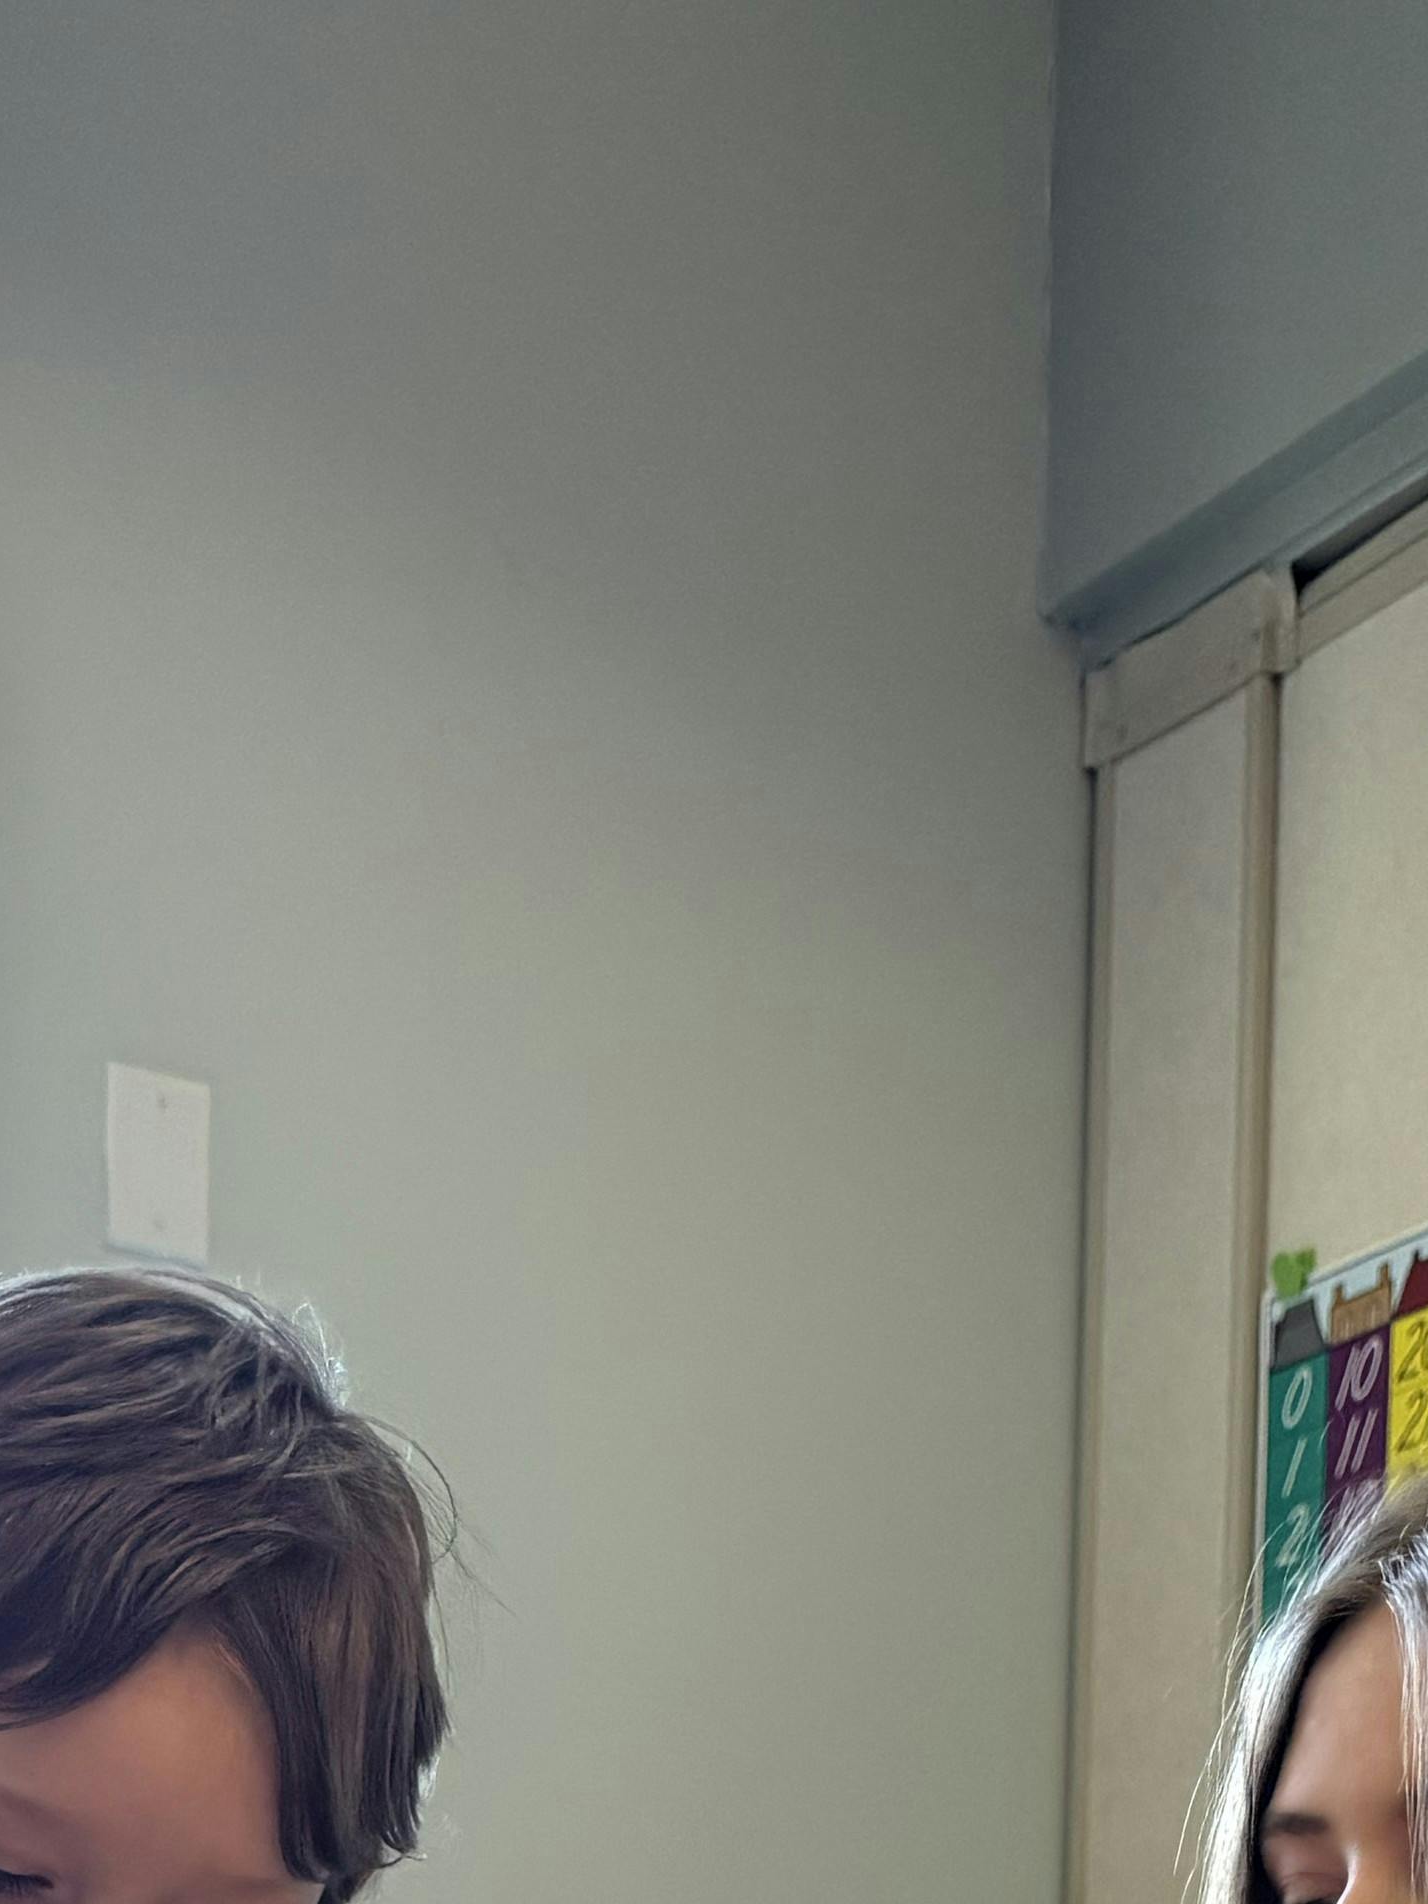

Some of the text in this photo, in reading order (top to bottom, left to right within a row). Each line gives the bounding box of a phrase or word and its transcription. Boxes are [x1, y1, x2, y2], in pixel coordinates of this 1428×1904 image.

[1280, 1366, 1313, 1429] 0
[1335, 1335, 1383, 1411] 10
[1281, 1438, 1307, 1499] 1
[1334, 1407, 1378, 1480] 11
[1275, 1502, 1310, 1568] 2
